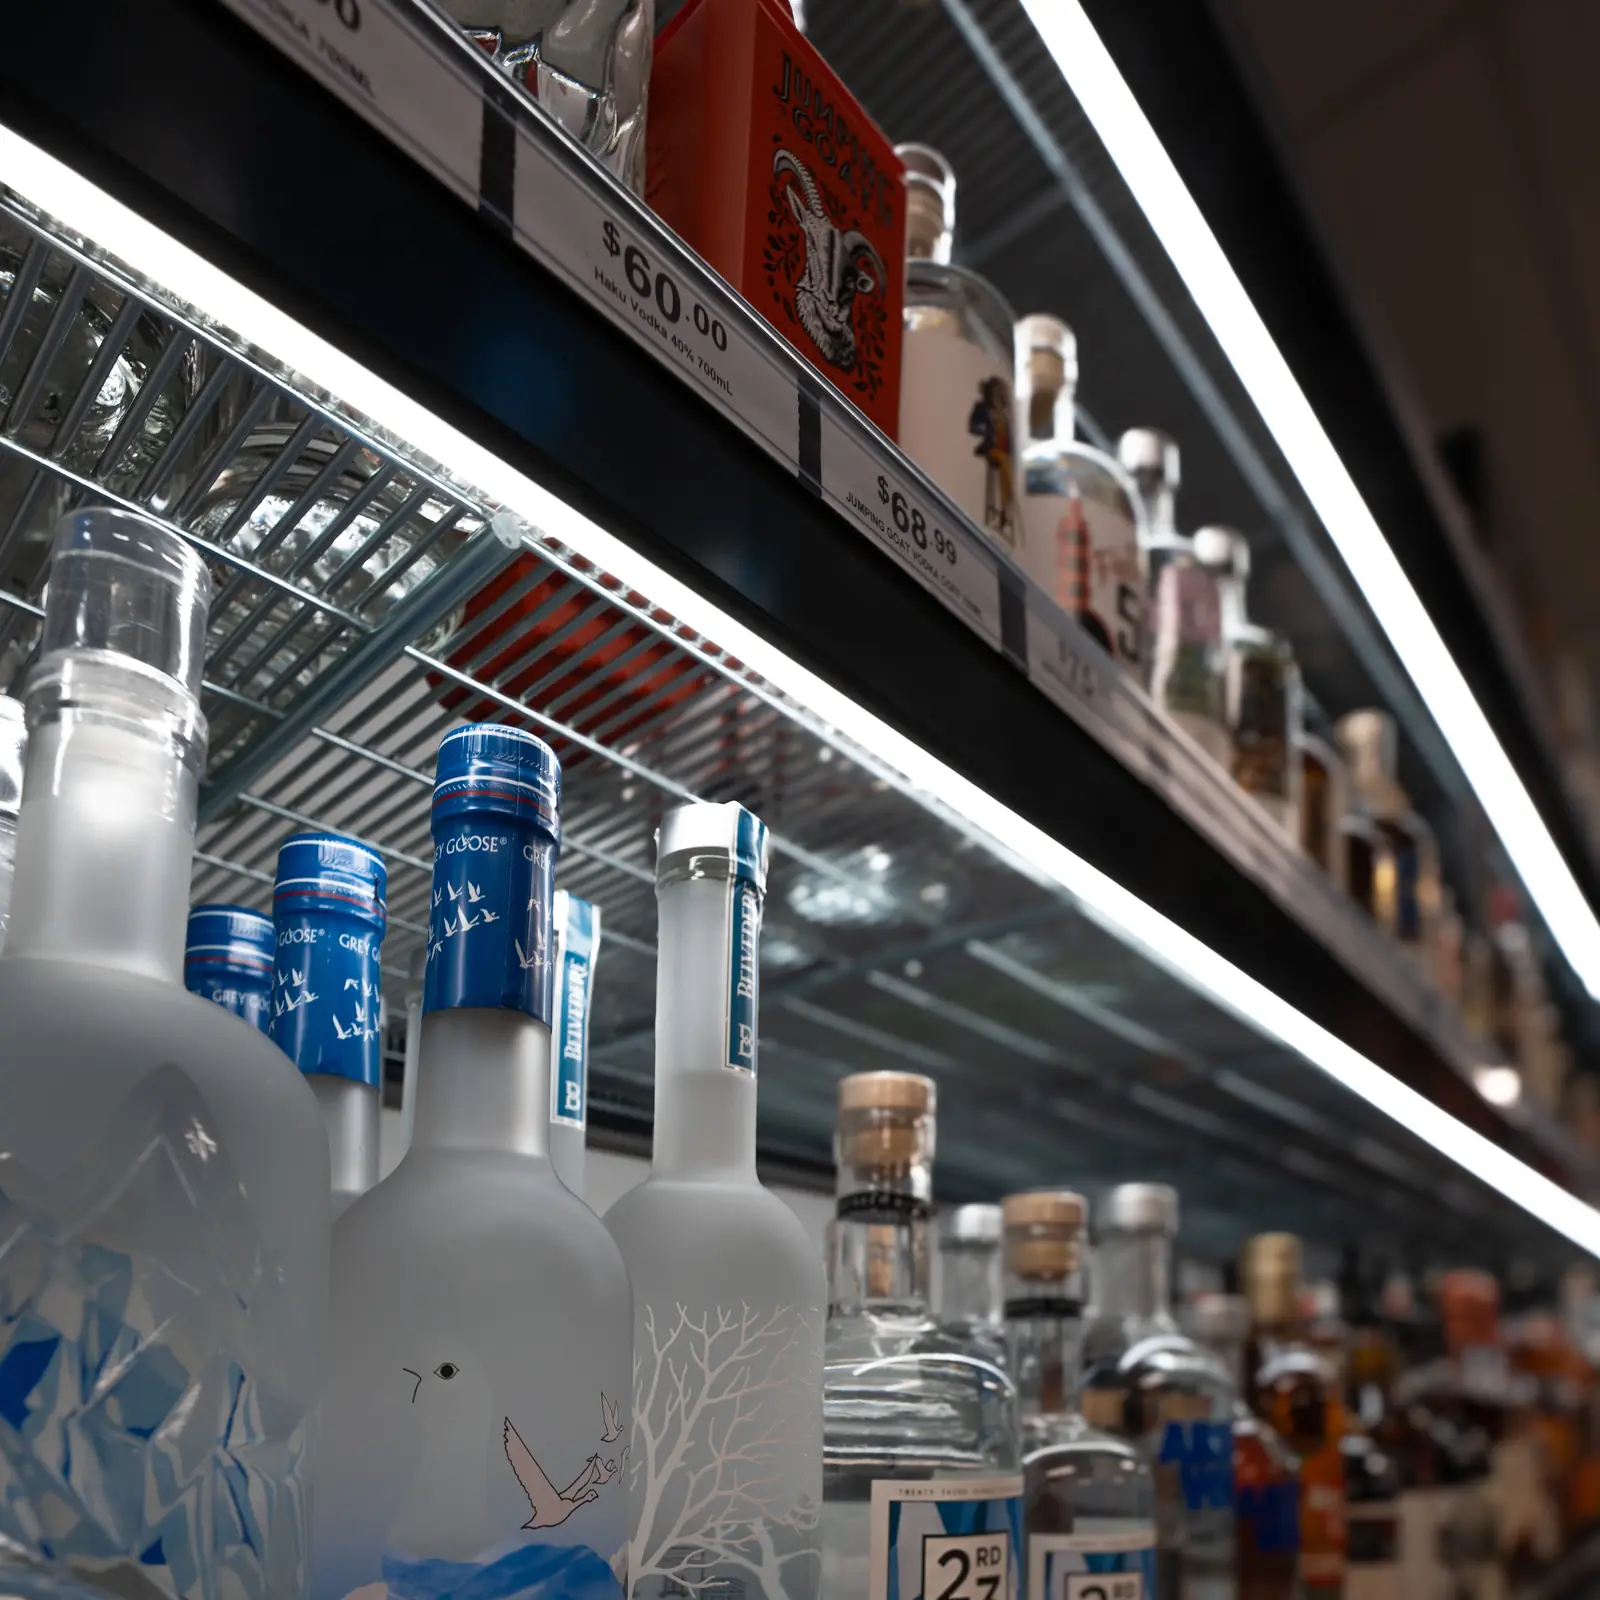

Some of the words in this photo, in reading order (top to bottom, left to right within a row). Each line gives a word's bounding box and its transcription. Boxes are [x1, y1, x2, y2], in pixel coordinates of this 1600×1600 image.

[593, 266, 628, 303] Haku
[630, 298, 668, 339] Vodka
[671, 334, 696, 364] 40%
[698, 356, 733, 396] 700mL
[602, 220, 728, 352] $60.00
[845, 491, 885, 533] JUMPING
[886, 526, 911, 552] GOAT
[876, 475, 957, 566] $68.99
[339, 933, 370, 956] GREY
